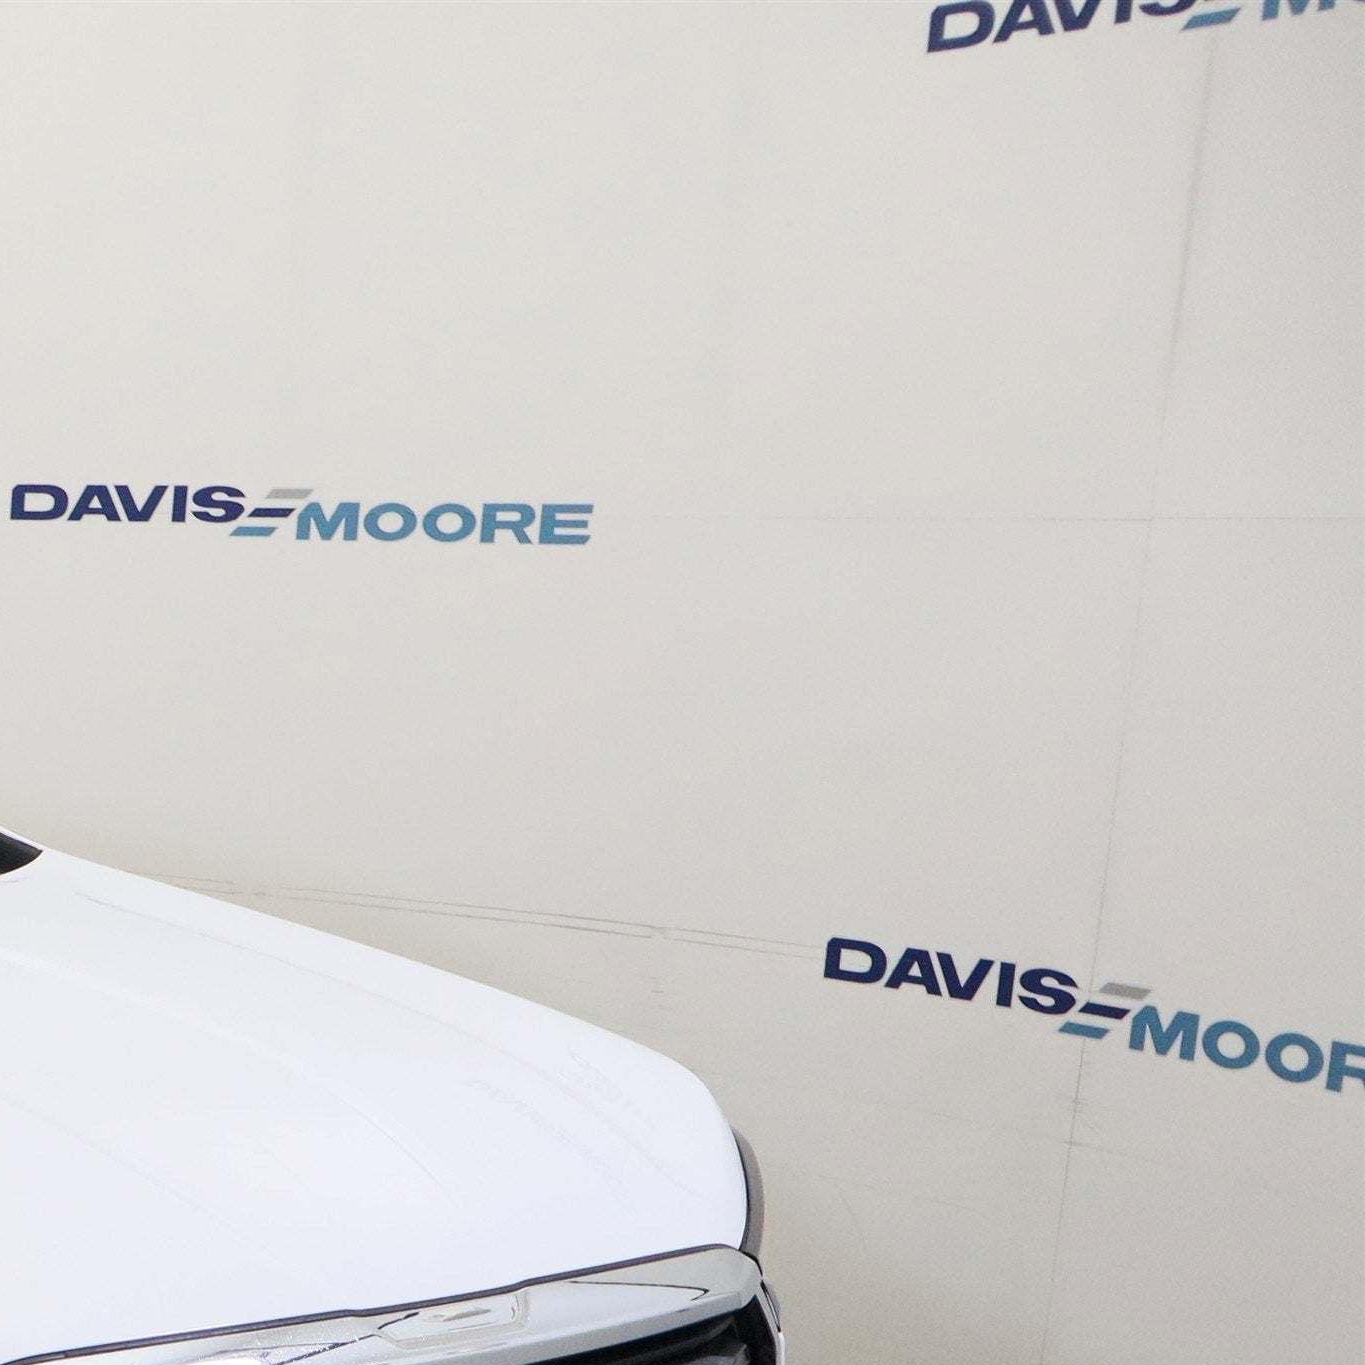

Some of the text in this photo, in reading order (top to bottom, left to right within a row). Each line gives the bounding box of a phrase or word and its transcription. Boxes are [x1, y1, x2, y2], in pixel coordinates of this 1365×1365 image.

[9, 483, 594, 545] DAVIS MOORE
[823, 937, 1079, 1015] DAVIS
